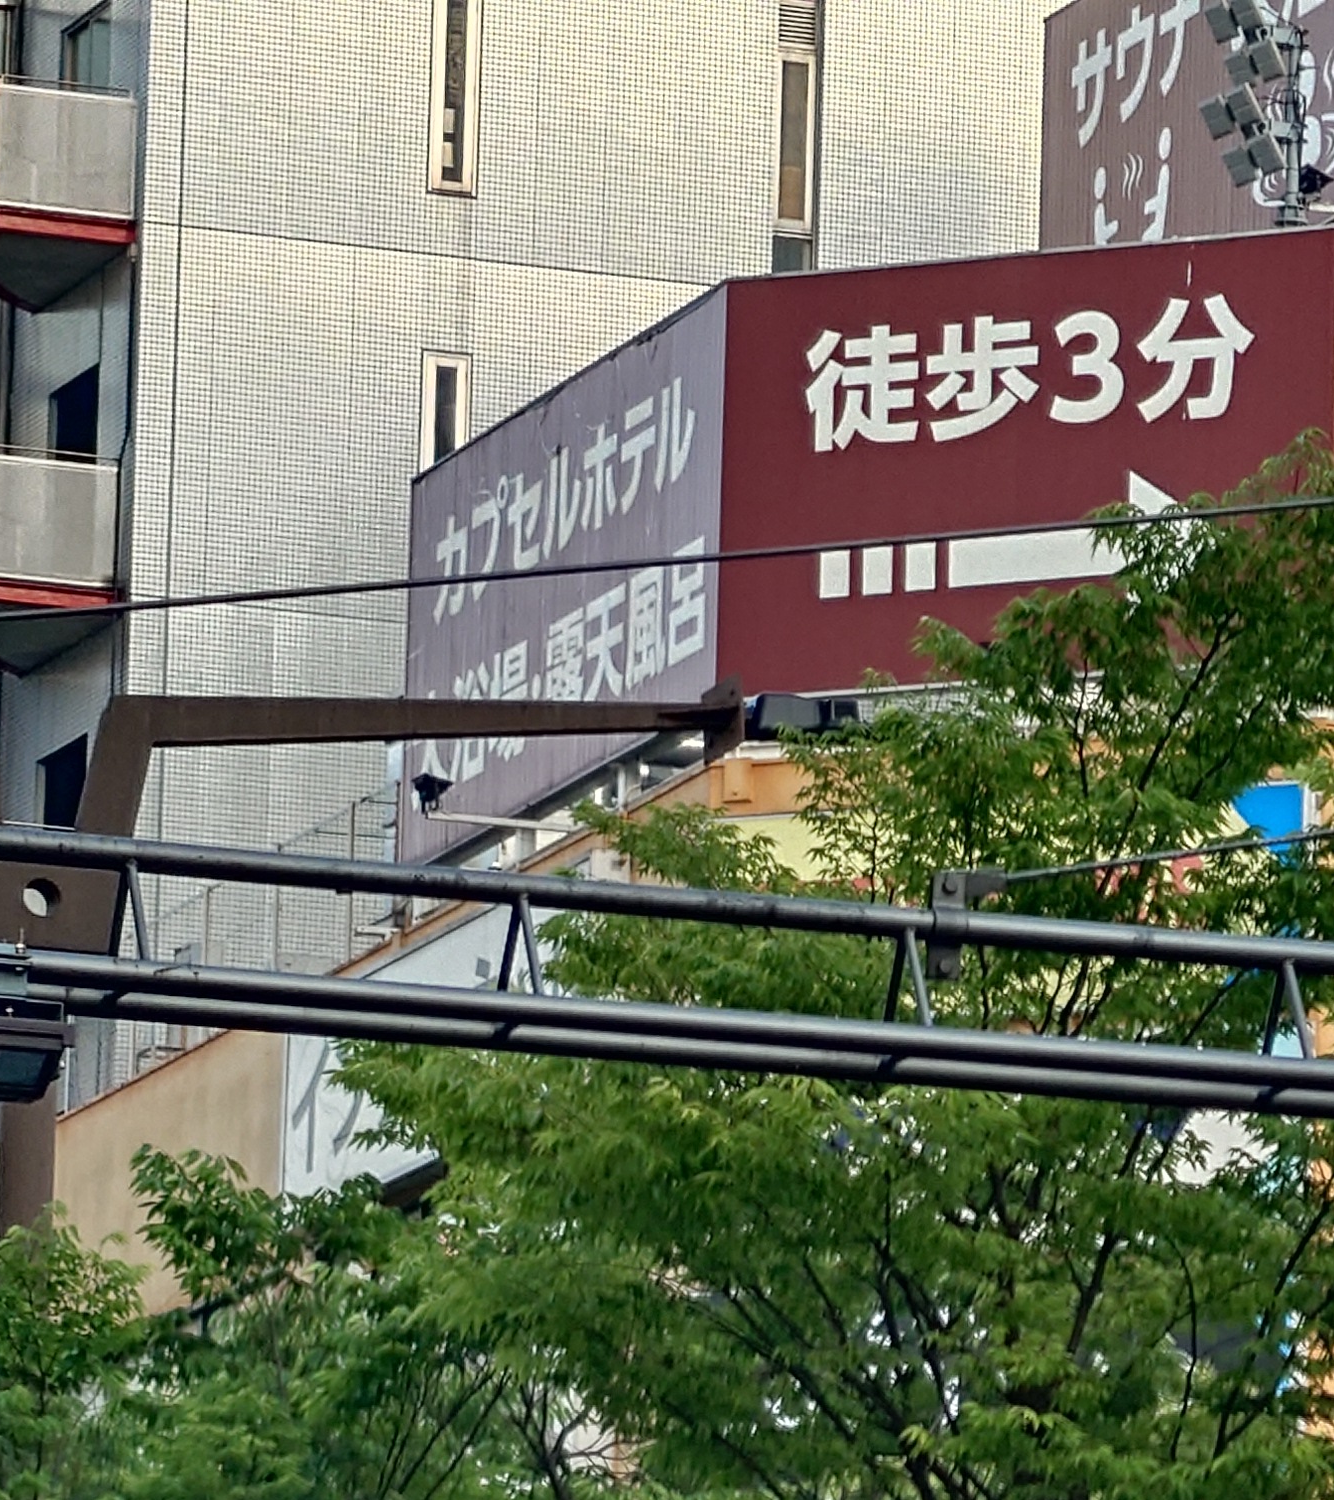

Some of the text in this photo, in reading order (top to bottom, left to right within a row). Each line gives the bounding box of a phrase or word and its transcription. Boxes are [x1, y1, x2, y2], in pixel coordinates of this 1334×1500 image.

[805, 293, 1256, 453] 徒歩3分
[433, 376, 696, 626] カプセルホテル
